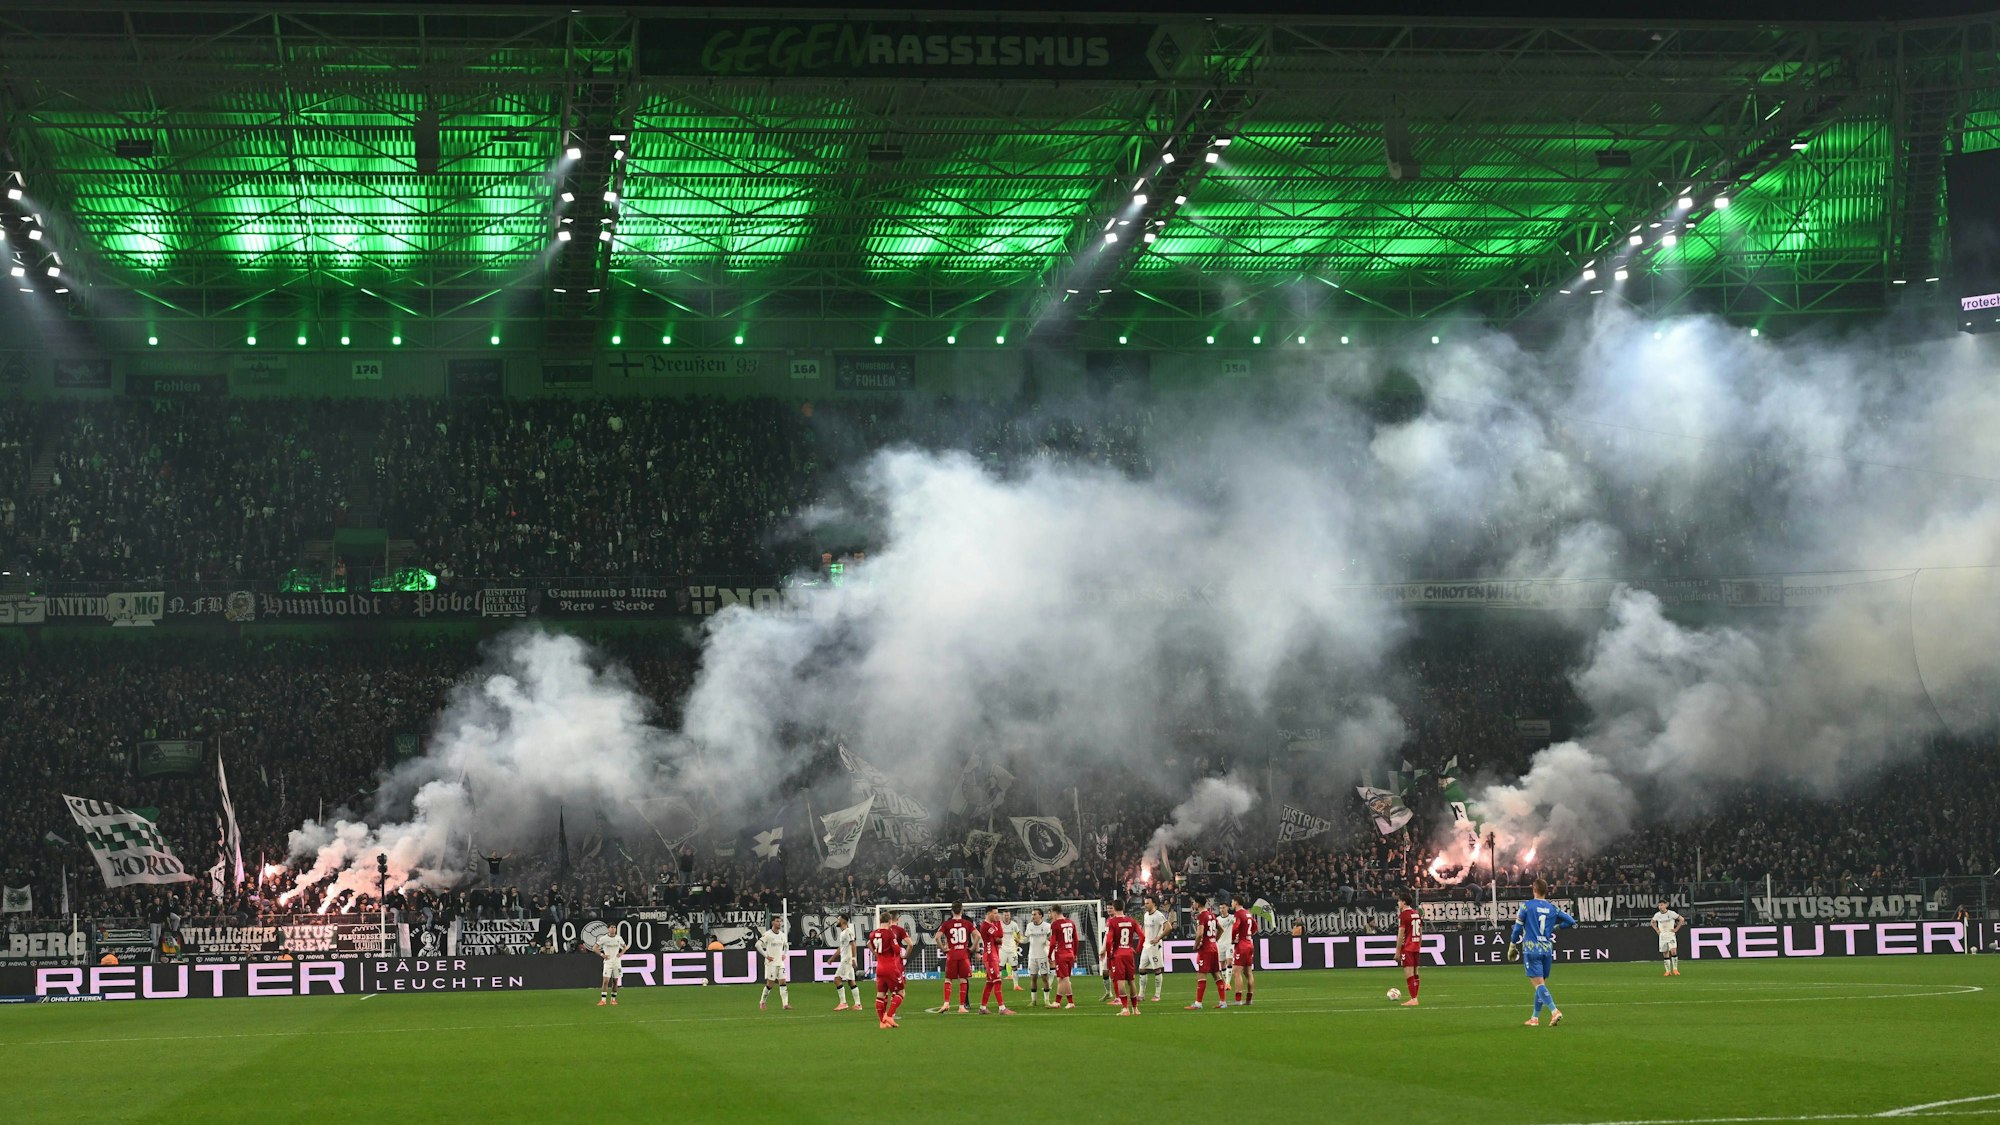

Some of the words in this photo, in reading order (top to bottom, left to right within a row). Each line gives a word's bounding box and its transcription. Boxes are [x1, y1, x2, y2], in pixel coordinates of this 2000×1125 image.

[700, 22, 874, 76] GEGEN
[868, 34, 1109, 68] RASSISMUS
[355, 365, 378, 375] 17A
[154, 380, 201, 392] Fohlen
[855, 374, 896, 387] FOHLEN
[547, 588, 626, 599] Commando
[631, 588, 667, 599] Ultra
[47, 597, 108, 616] UNITED
[134, 596, 159, 615] MG
[260, 593, 381, 618] Humboldt
[413, 591, 482, 617] Pöbel
[1616, 893, 1691, 909] PUMUKL
[1751, 894, 1923, 919] VITUSSTADT
[687, 911, 766, 924] FRONTLINE
[1538, 914, 1546, 936] 1
[282, 925, 335, 939] VITUS
[463, 920, 536, 932] BORUSSIA
[179, 926, 277, 944] WILLICHER
[949, 927, 967, 944] 30
[1062, 927, 1074, 943] 18
[1120, 928, 1130, 945] 8
[1690, 921, 1965, 959] REUTER
[199, 943, 262, 952] FOHLEN
[284, 938, 332, 951] CREW
[1163, 934, 1447, 972] RUTER
[376, 959, 467, 973] BÄDER
[36, 961, 346, 999] REUTER
[376, 976, 523, 990] LEUCHTEN
